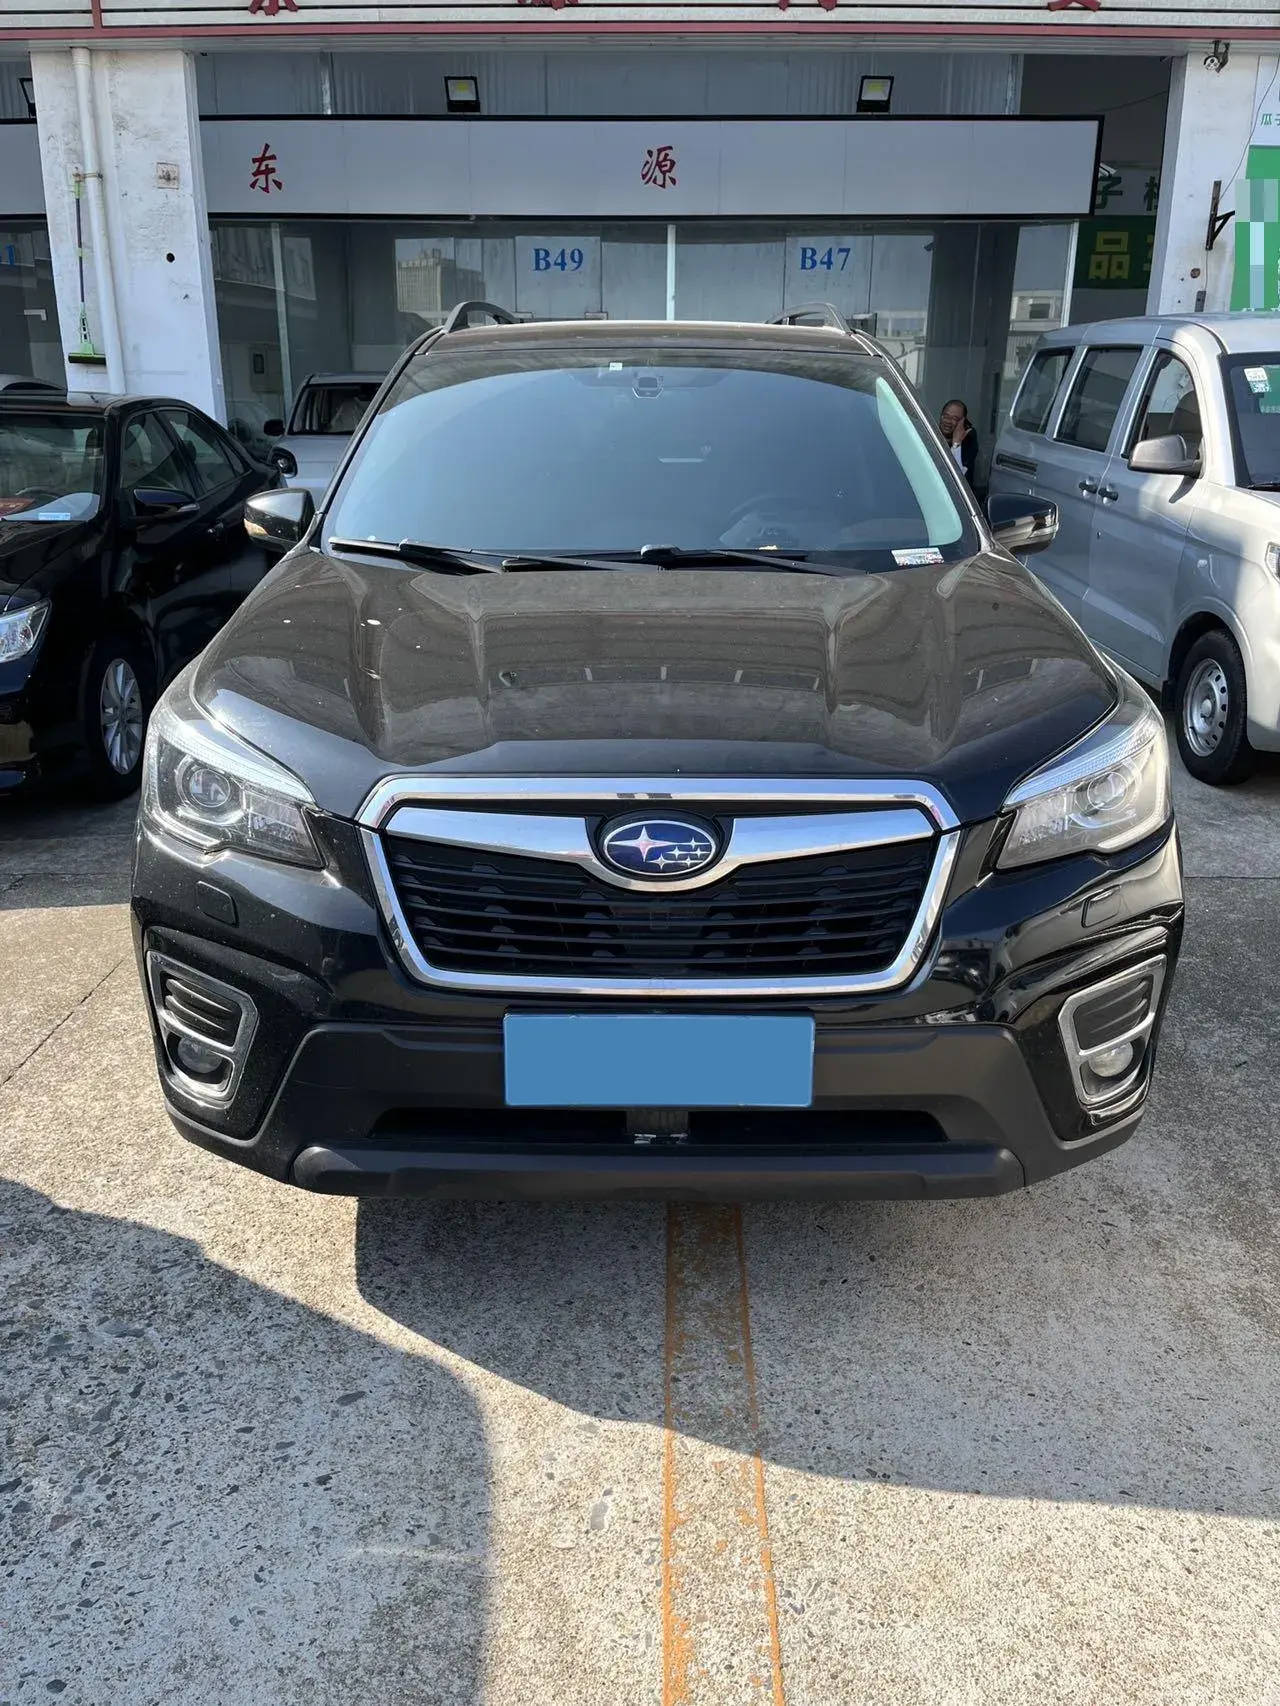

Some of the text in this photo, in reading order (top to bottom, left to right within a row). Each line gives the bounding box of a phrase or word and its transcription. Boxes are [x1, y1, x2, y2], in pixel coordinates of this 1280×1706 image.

[249, 142, 677, 193] 东 源
[532, 247, 584, 272] B49
[799, 246, 851, 271] B47
[1088, 231, 1155, 280] 品
